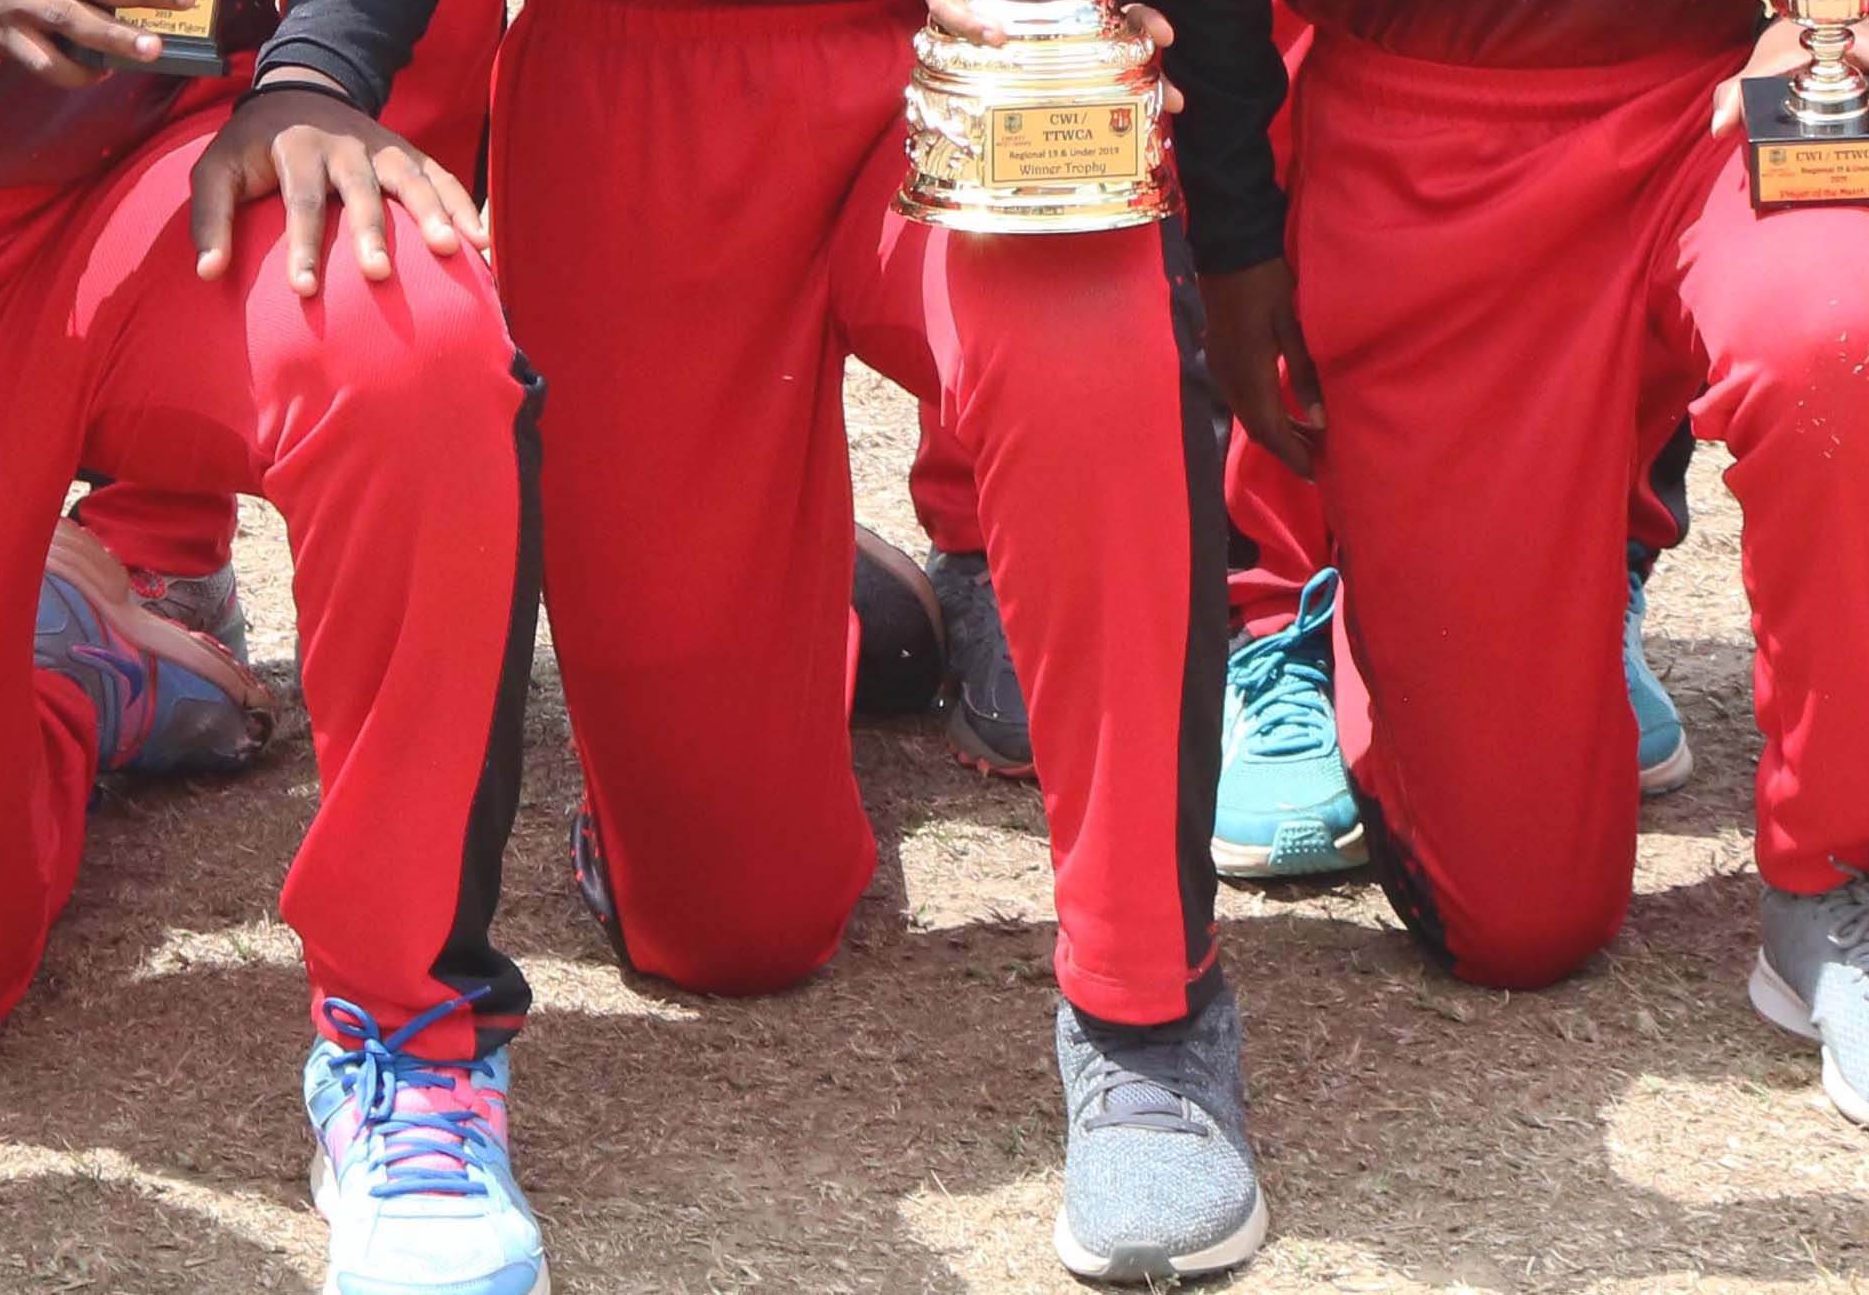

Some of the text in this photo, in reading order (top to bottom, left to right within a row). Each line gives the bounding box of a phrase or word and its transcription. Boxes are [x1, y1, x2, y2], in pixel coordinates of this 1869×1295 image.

[1050, 113, 1079, 125] CWI
[1043, 129, 1093, 141] TTWCA
[1009, 150, 1045, 160] Regional
[1070, 147, 1096, 157] Under
[1099, 146, 1119, 156] 2019
[1019, 162, 1106, 176] Winner Trophy
